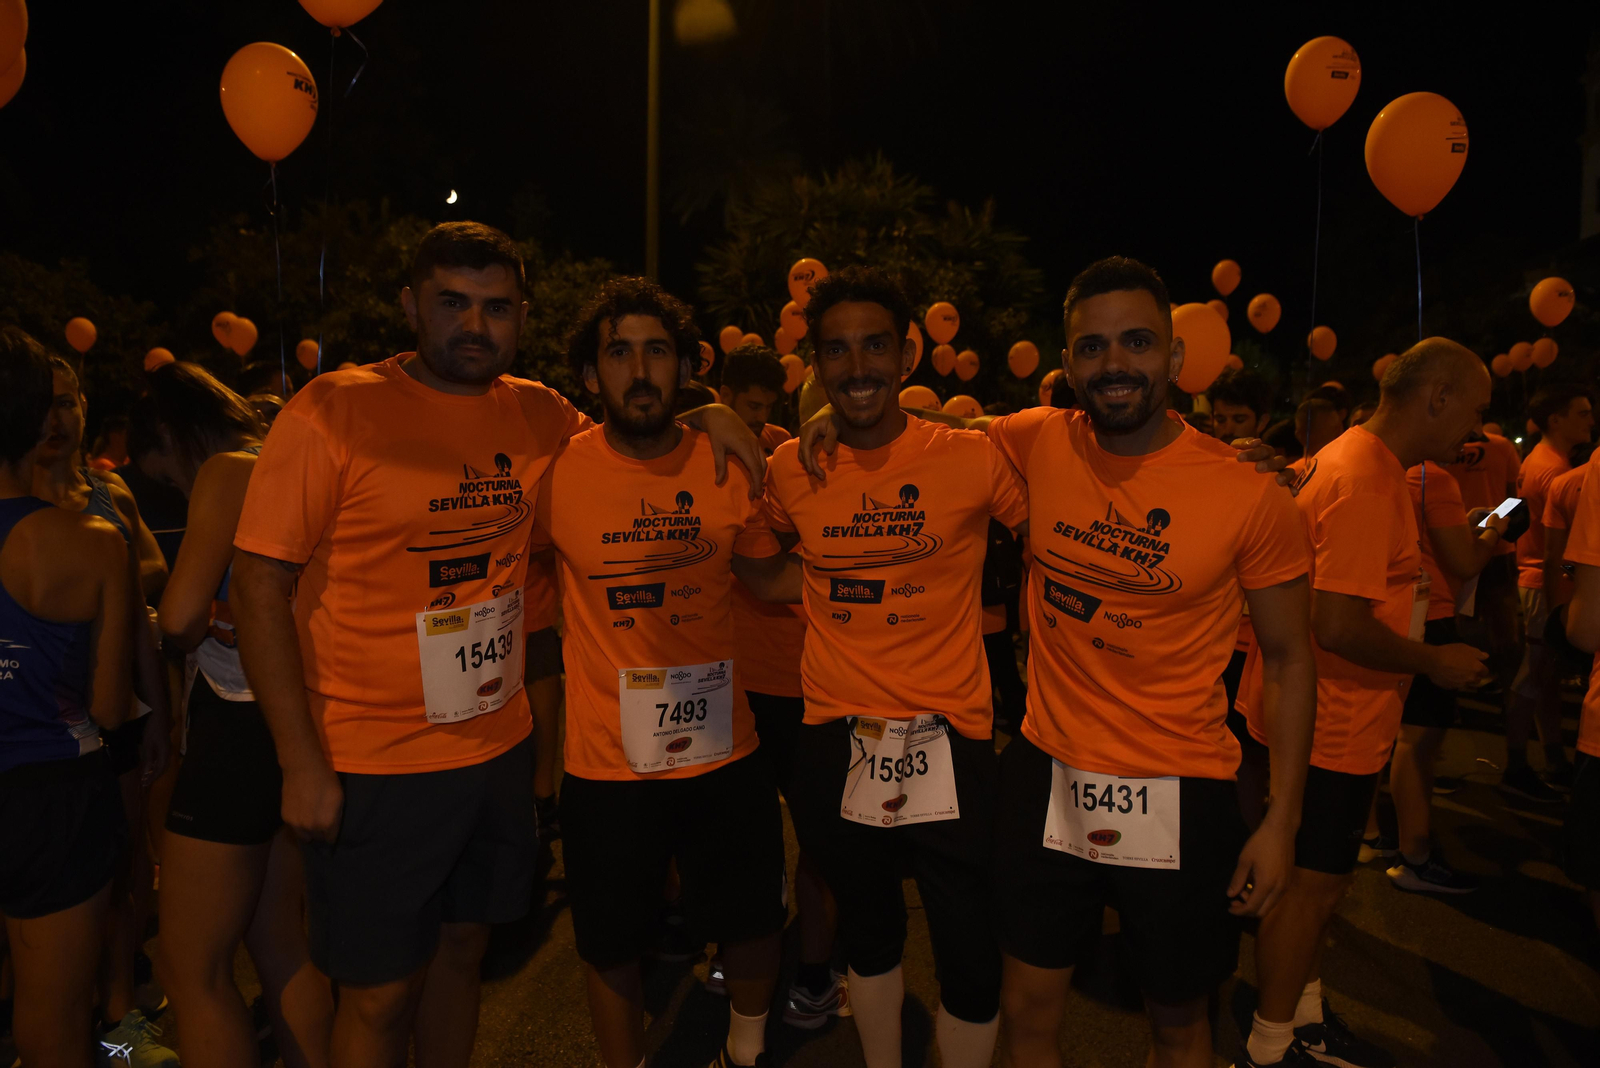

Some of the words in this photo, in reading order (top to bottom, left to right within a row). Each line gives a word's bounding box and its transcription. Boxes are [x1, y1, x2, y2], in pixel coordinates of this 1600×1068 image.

[459, 479, 522, 494] NOCTURNA
[429, 495, 490, 513] SEVILLA
[633, 516, 701, 529] NOCTURNA
[852, 511, 926, 523] NOCTURNA
[601, 529, 664, 544] SEVILLA
[822, 525, 884, 538] SEVILLA
[1053, 520, 1118, 556] SEVILLA
[1089, 520, 1171, 555] NOCTURNA
[613, 619, 631, 628] KH7
[455, 630, 513, 672] 15439
[656, 698, 707, 728] 7493
[673, 727, 693, 735] DELGADO
[867, 750, 928, 783] 15933
[1070, 780, 1147, 814] 15431
